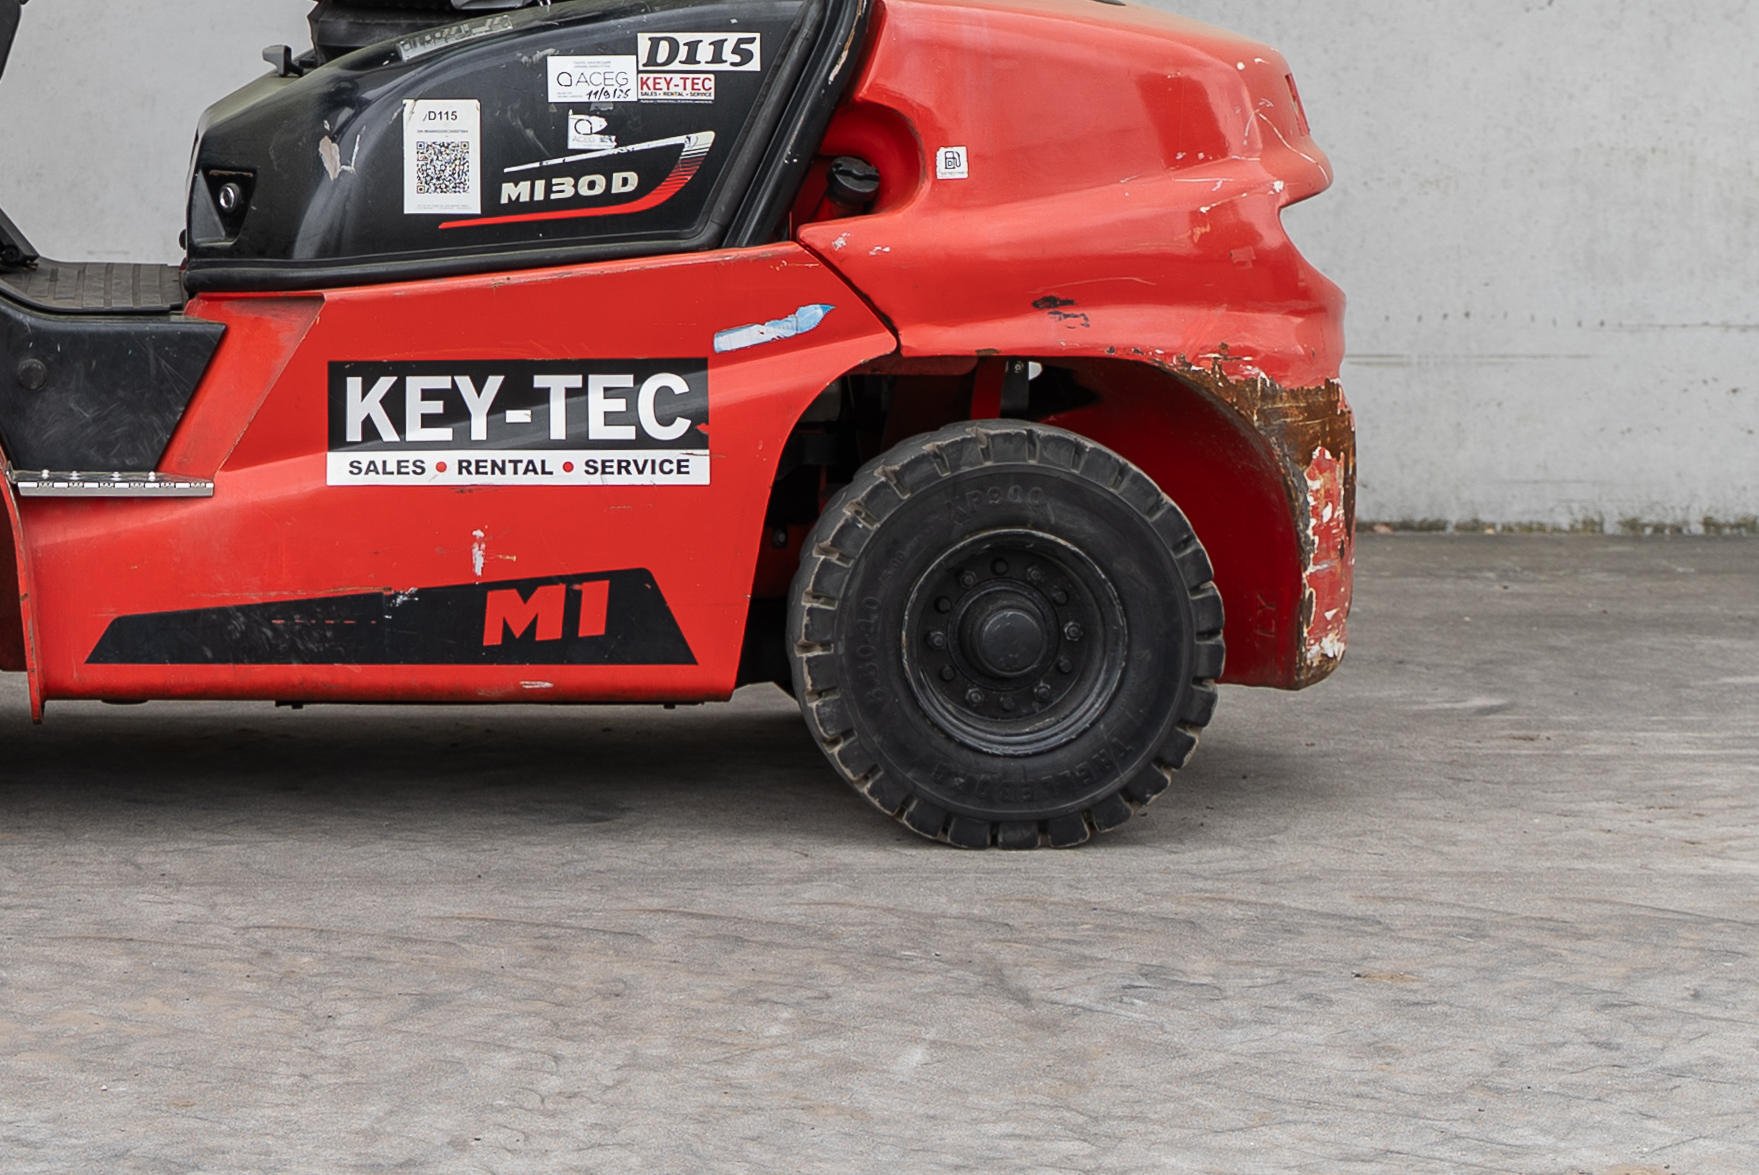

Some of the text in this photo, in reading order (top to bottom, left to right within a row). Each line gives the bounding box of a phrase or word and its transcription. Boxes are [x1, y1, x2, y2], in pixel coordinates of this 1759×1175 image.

[642, 36, 757, 68] D115
[575, 71, 629, 87] ACEG
[639, 76, 713, 91] KEY-TEC
[345, 372, 692, 444] KEY-TEC
[348, 457, 691, 477] SALES RENTAL SERVICE
[945, 485, 1046, 528] XP900
